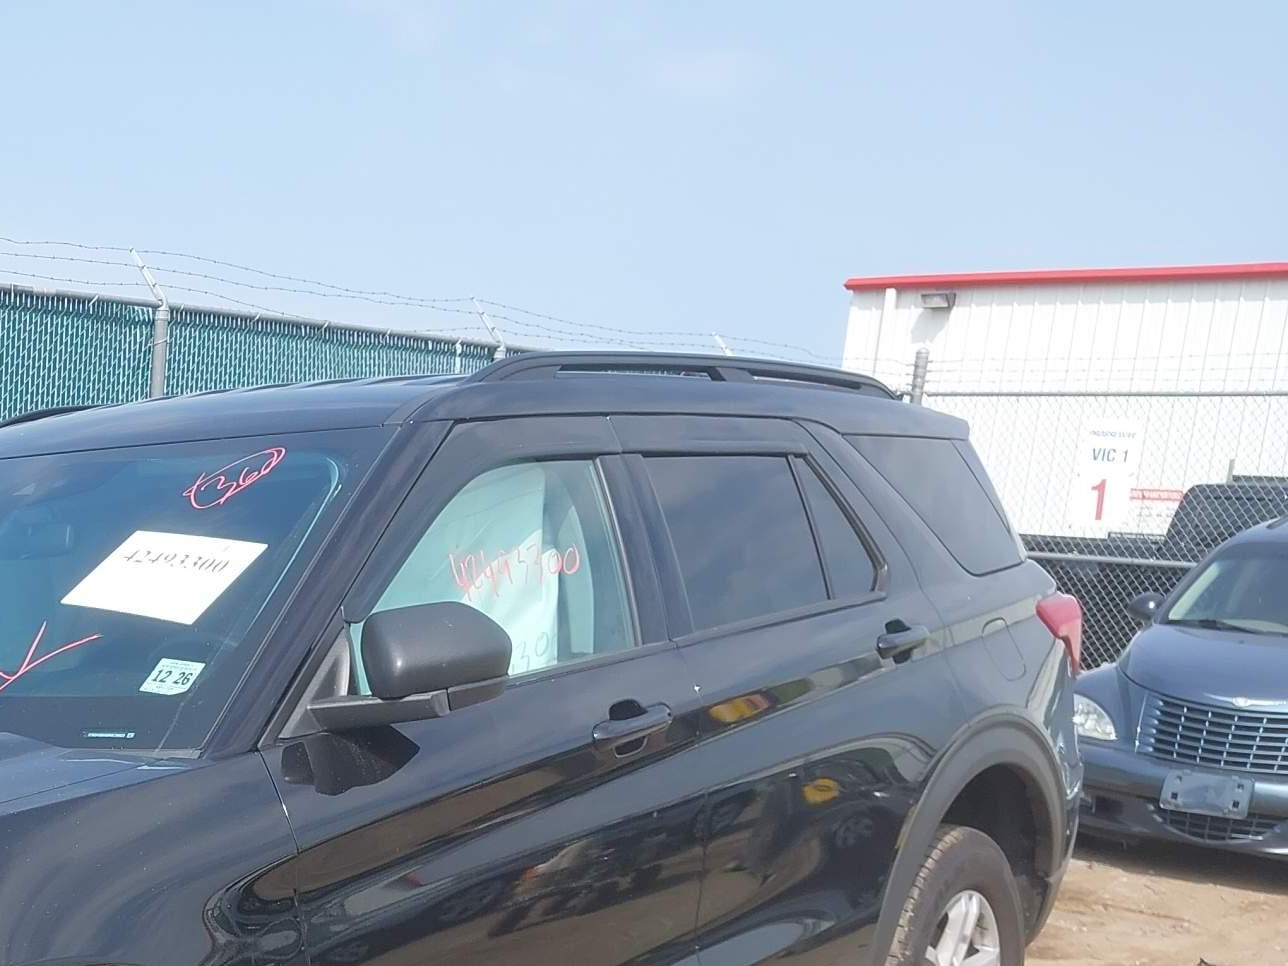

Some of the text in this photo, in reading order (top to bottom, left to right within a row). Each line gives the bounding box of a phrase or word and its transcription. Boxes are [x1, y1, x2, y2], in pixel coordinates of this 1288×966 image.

[1092, 447, 1129, 462] VIC 1
[200, 453, 278, 505] 360
[1091, 478, 1107, 520] 1
[152, 669, 193, 686] 12 26
